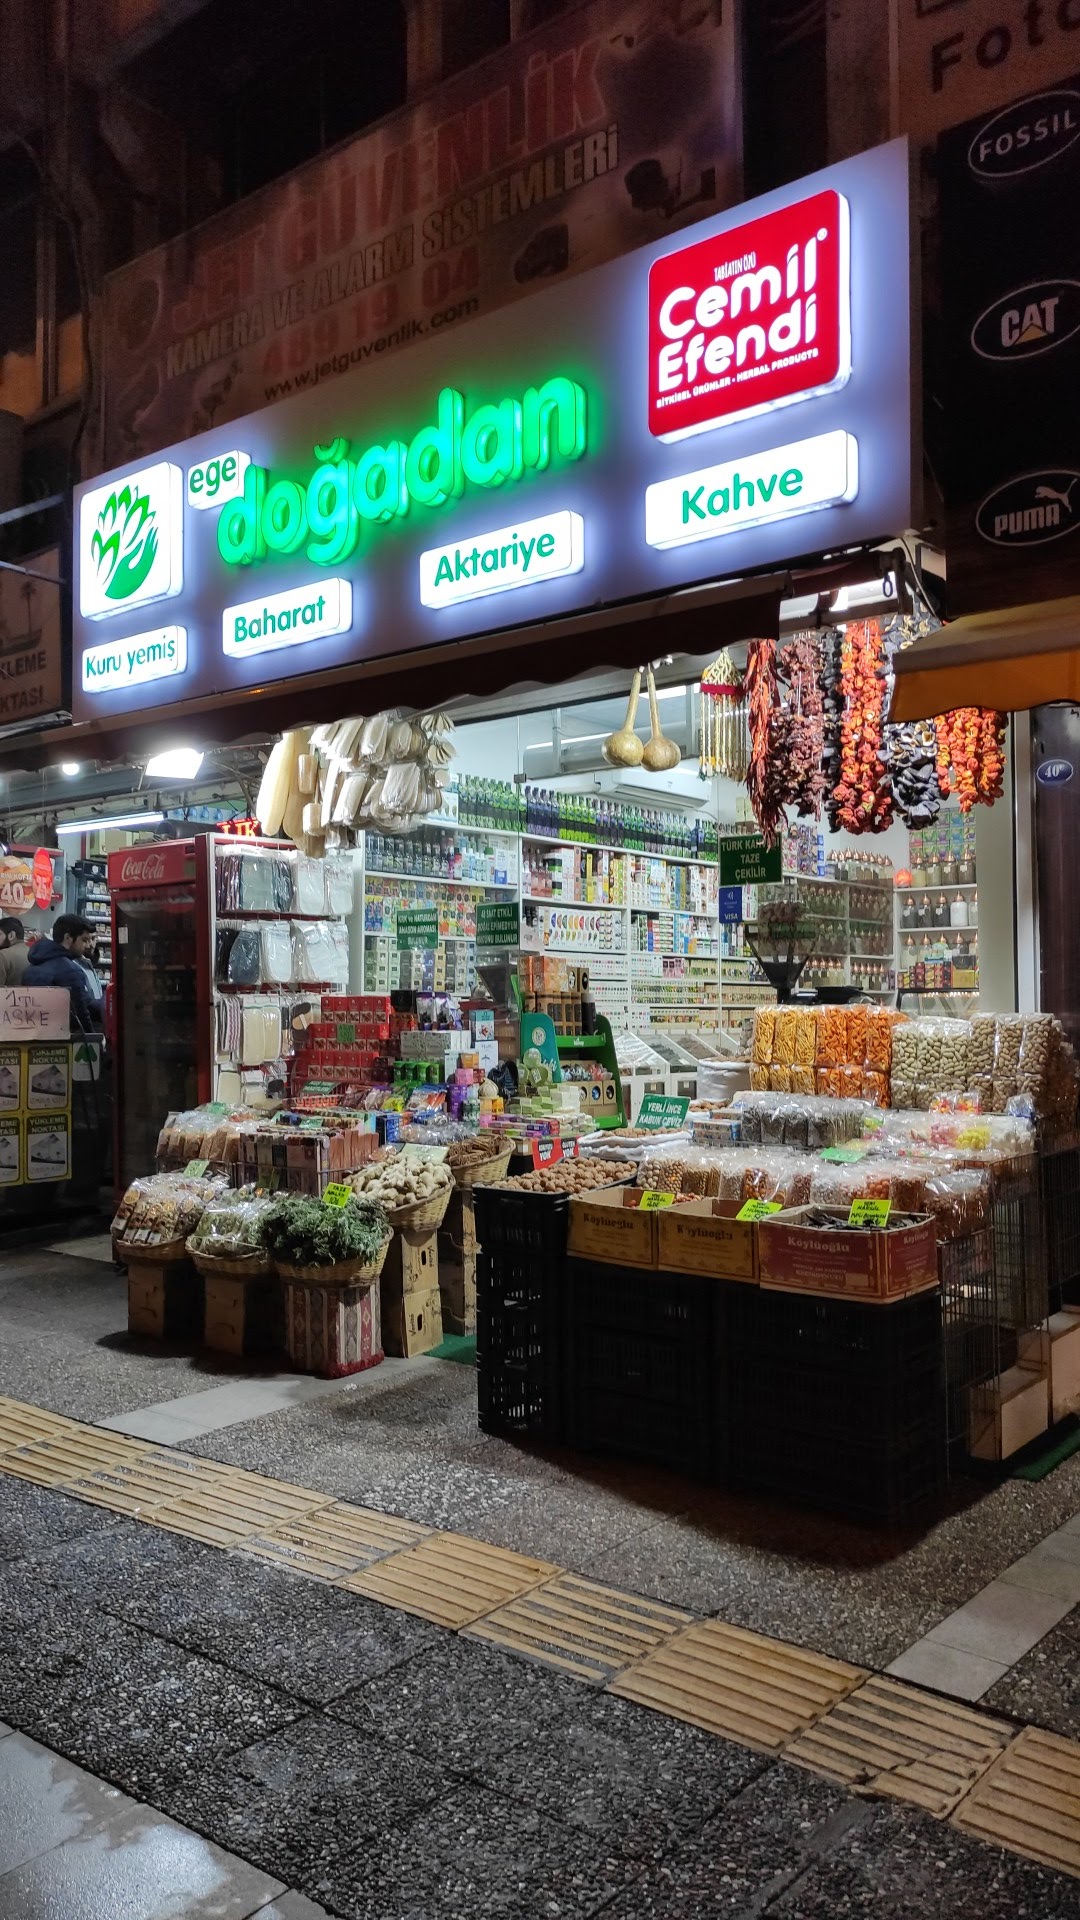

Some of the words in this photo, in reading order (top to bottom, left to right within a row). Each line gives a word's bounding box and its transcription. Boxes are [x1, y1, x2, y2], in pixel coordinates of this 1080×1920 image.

[980, 108, 1076, 162] FOSSIL
[422, 245, 480, 308] 04
[659, 237, 817, 339] Cemil
[167, 300, 266, 380] KAMERA
[272, 279, 306, 330] VE
[311, 223, 415, 313] ALARM
[1001, 297, 1059, 347] CAT
[264, 297, 480, 402] www.jetguvenlik.com
[659, 293, 817, 392] Efendi
[737, 364, 770, 383] HERBAL
[771, 347, 819, 371] PRODUCTS
[189, 456, 236, 496] ege
[217, 377, 586, 566] doğadan
[683, 468, 804, 525] Kahve
[994, 503, 1059, 537] PUMA
[434, 531, 555, 587] Aktariye
[234, 595, 326, 642] Baharat
[86, 653, 120, 678] Kuru
[126, 635, 176, 674] yemiş
[721, 839, 743, 852] TÜRK
[740, 853, 760, 864] TAZE
[1, 882, 25, 905] 40
[735, 865, 766, 881] ÇEKİLİR
[32, 1056, 66, 1064] NOKTASI
[31, 1125, 65, 1134] NOKTASI
[787, 1235, 850, 1253] Köylüoğlu
